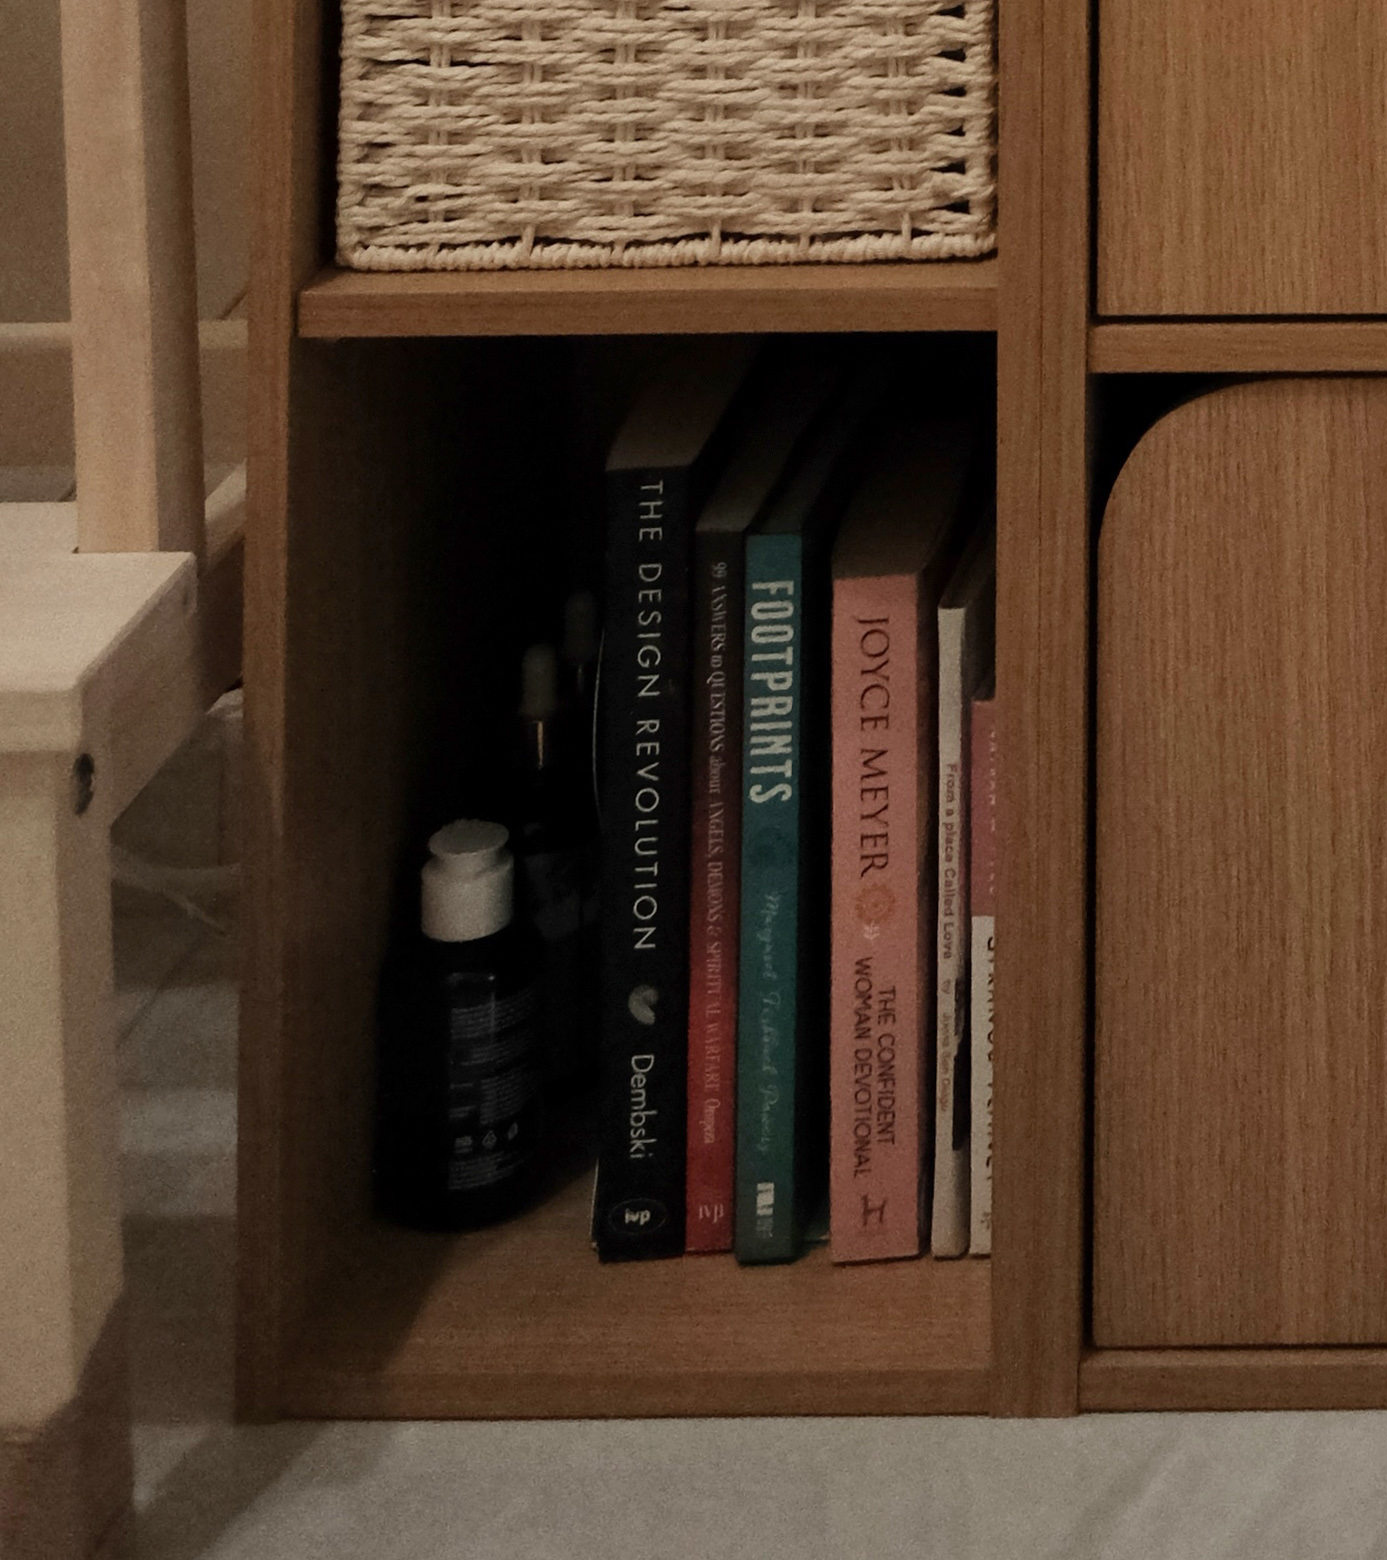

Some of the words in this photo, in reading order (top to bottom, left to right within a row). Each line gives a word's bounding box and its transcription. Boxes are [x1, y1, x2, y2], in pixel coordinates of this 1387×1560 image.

[638, 480, 664, 542] THE
[636, 563, 663, 698] DESIGN
[854, 616, 891, 732] JOYCE
[749, 580, 794, 804] FOOTPRINTS
[860, 747, 889, 879] MEYER
[946, 808, 954, 817] a
[947, 763, 958, 803] From
[632, 720, 660, 950] REVOLUTION
[942, 822, 955, 863] place
[943, 868, 956, 918] Called
[943, 920, 952, 959] Love
[855, 957, 873, 1040] WOMAN
[878, 985, 896, 1024] THE
[630, 1054, 657, 1159] Dembski
[854, 1048, 872, 1178] DEVOTIONAL
[877, 1037, 896, 1145] CONFIDENT
